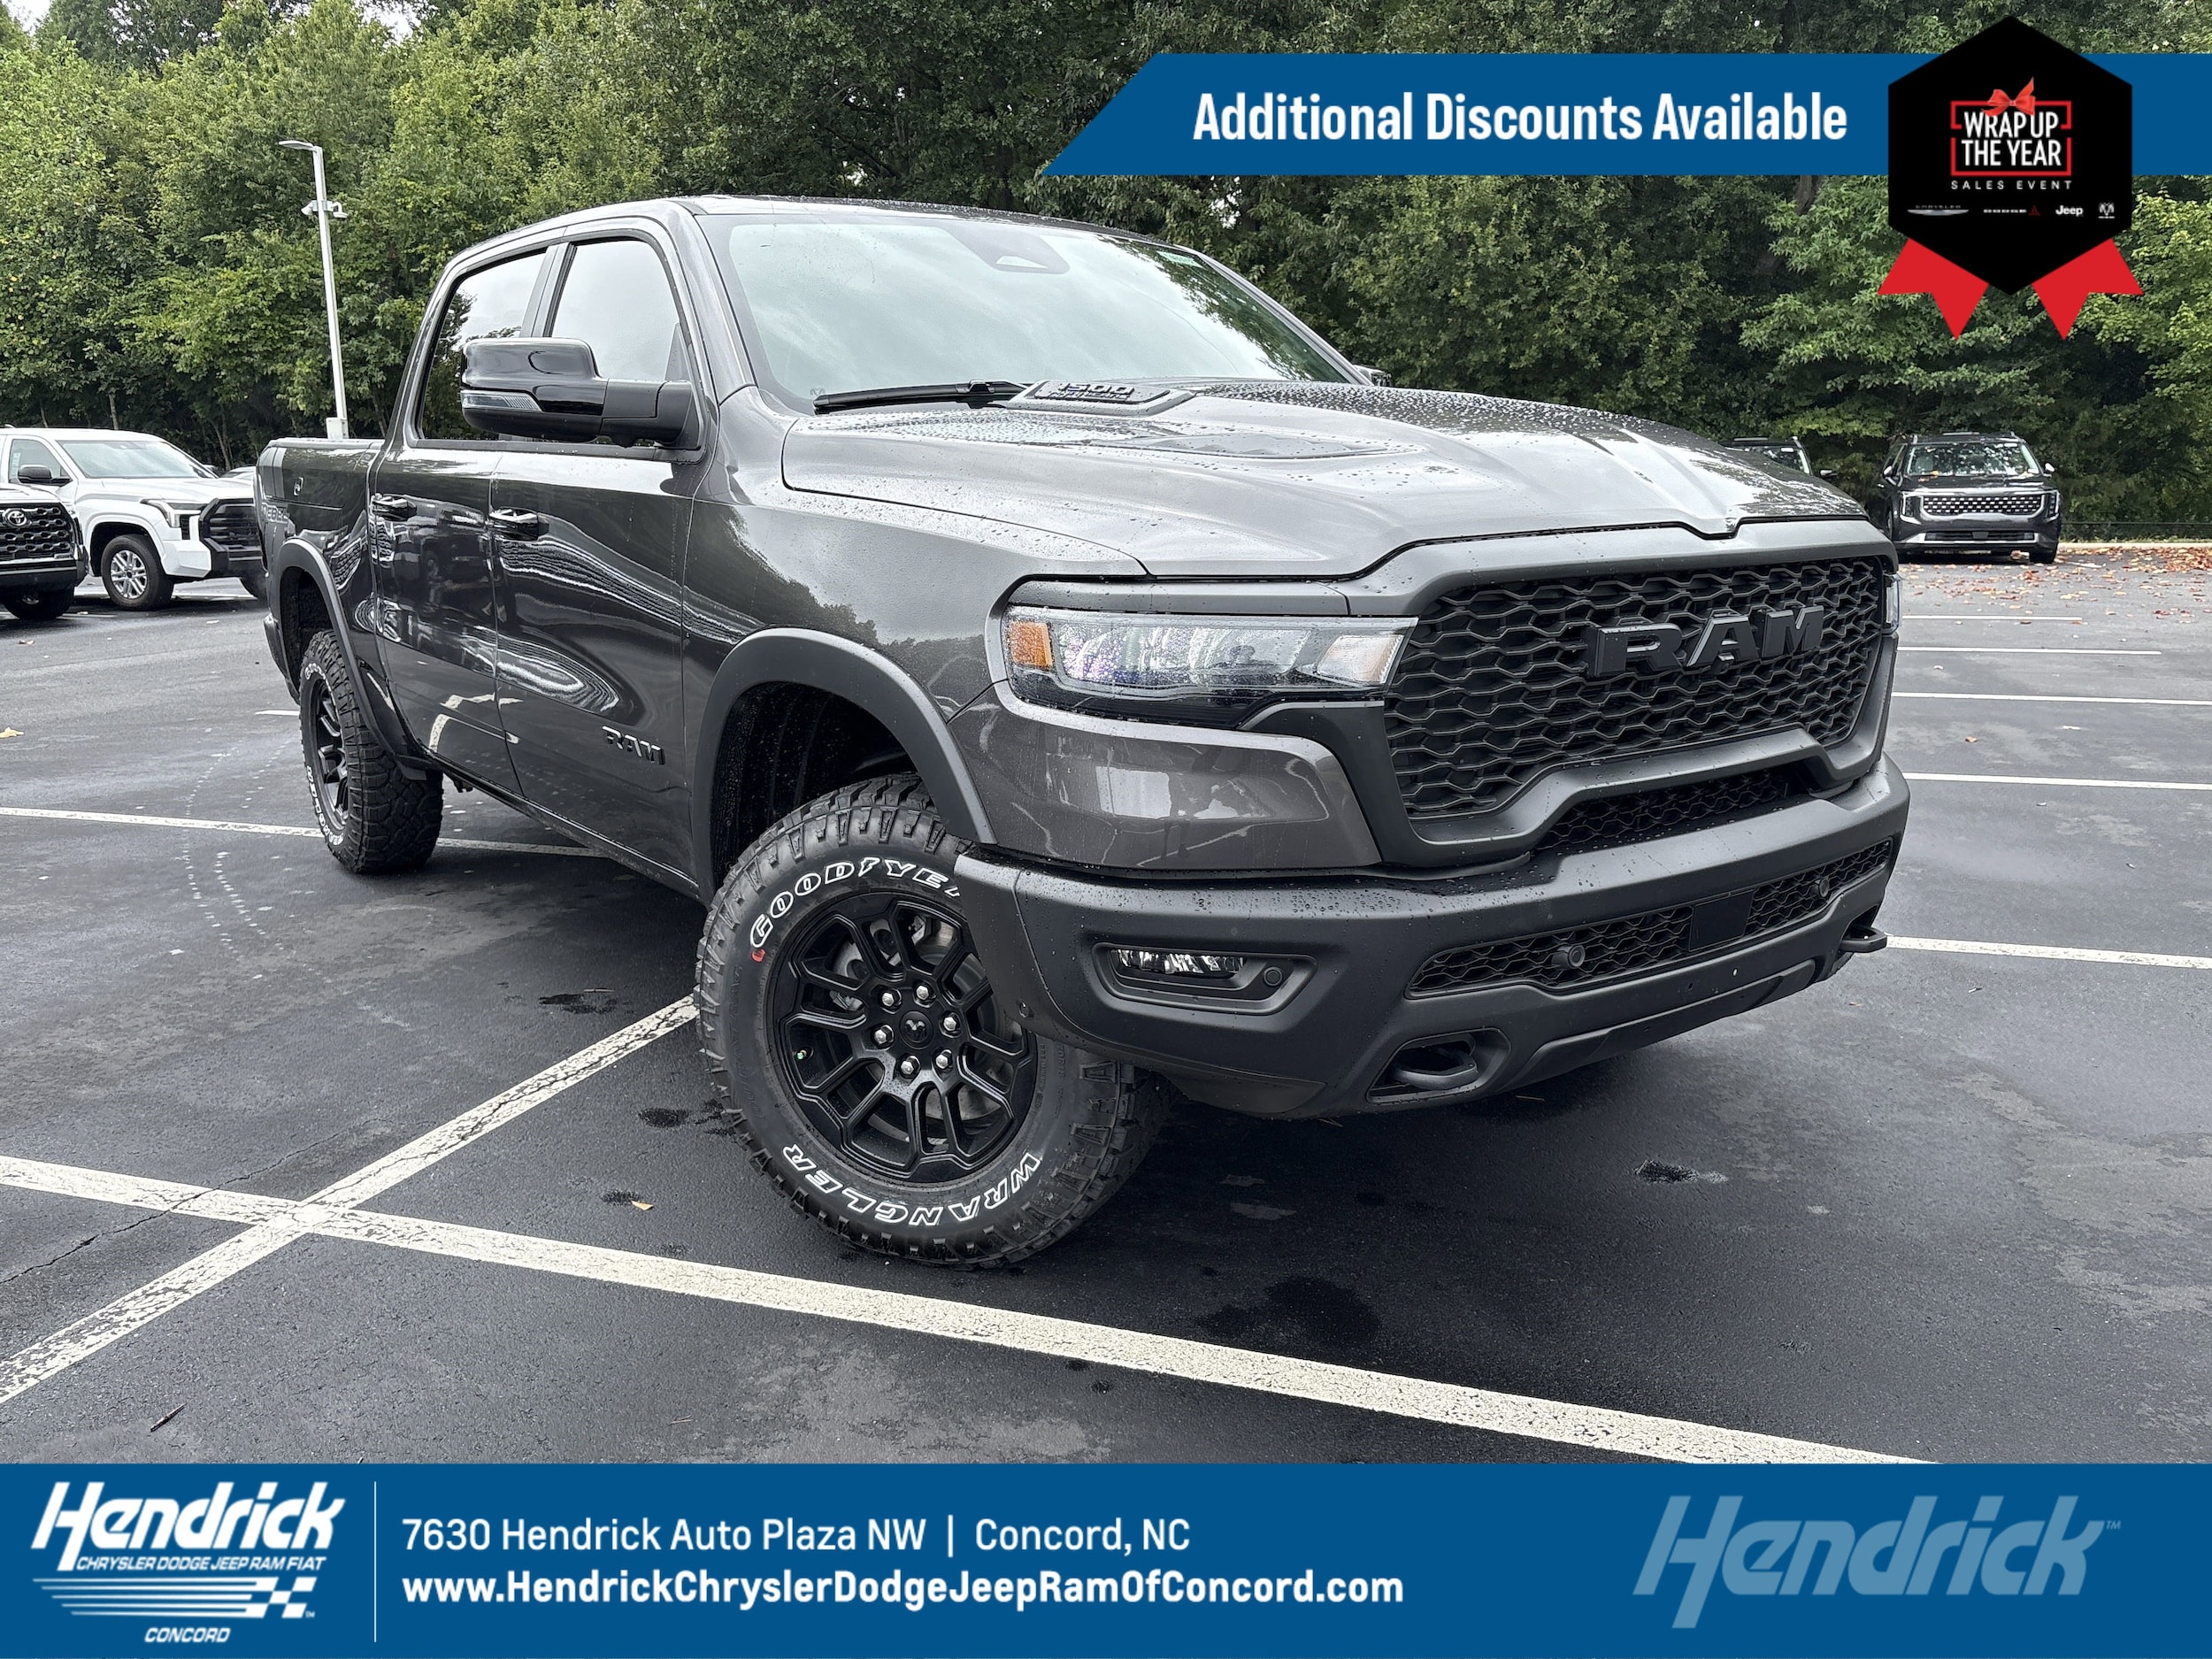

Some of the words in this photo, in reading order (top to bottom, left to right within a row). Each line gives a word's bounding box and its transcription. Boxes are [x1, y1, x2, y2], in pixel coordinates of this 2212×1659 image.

[1594, 605, 1824, 678] RAM
[602, 726, 665, 766] RAM
[750, 856, 961, 948] GOODYE
[782, 1143, 1042, 1226] WRANGLER
